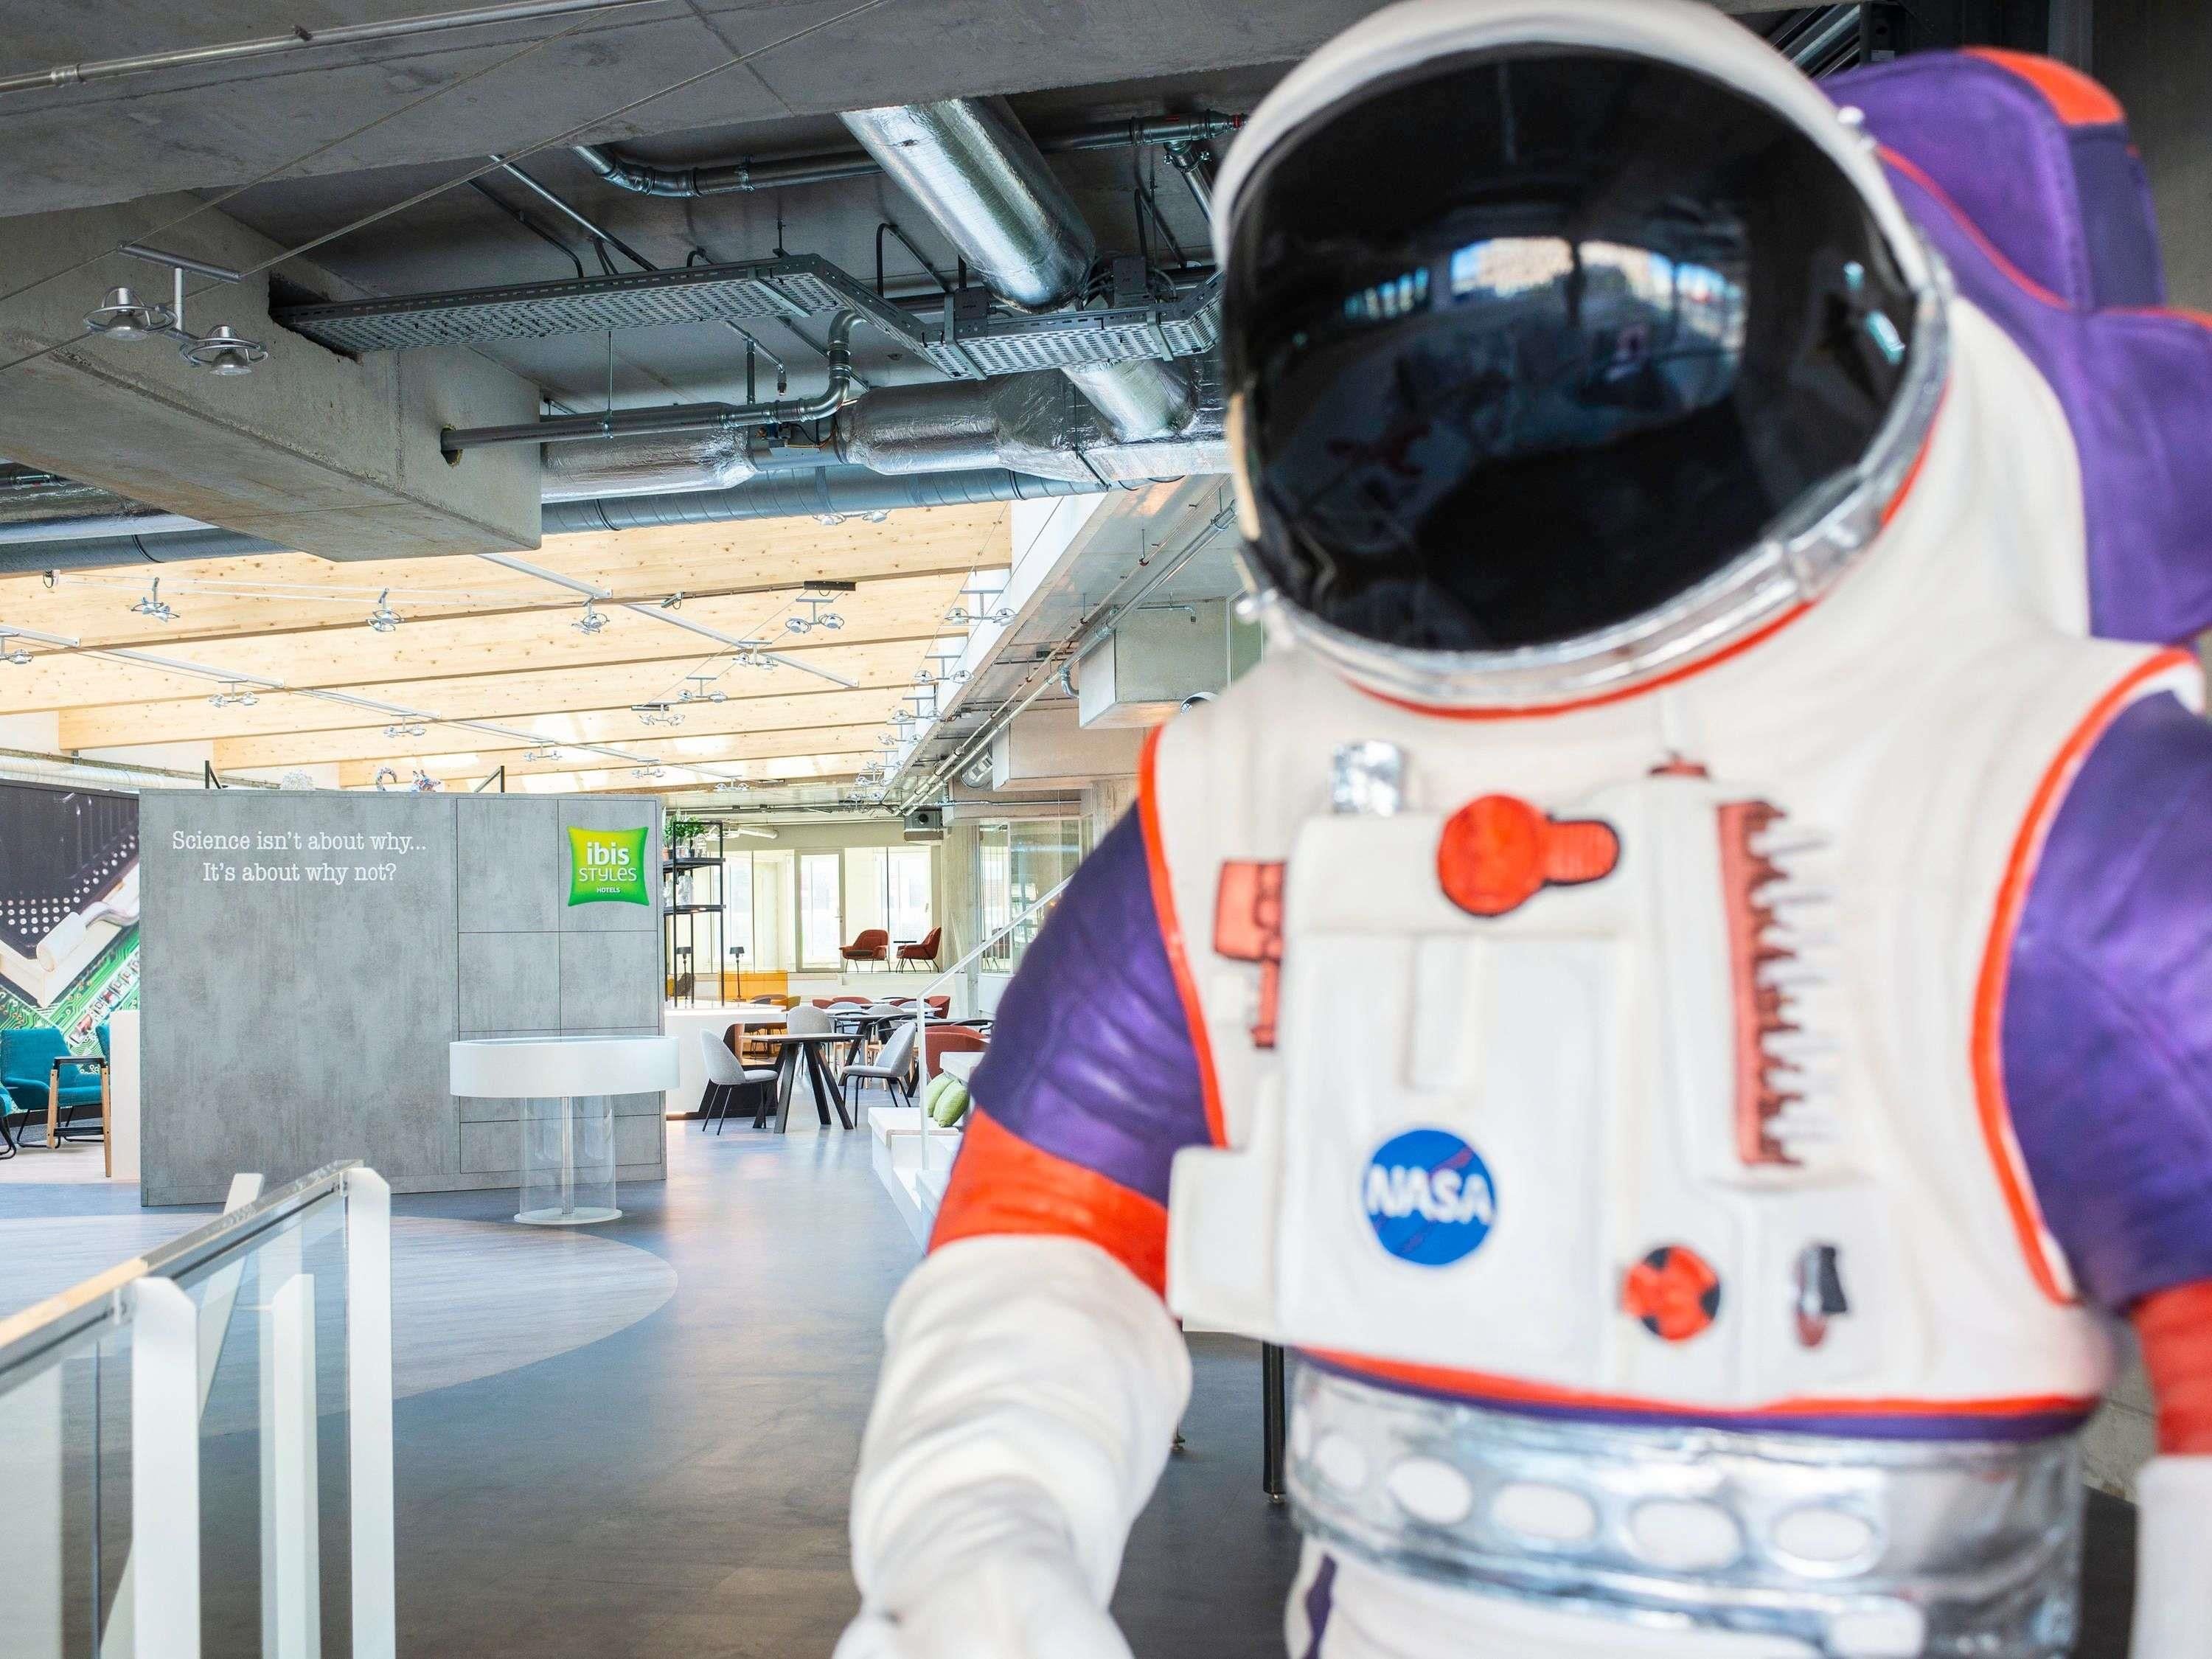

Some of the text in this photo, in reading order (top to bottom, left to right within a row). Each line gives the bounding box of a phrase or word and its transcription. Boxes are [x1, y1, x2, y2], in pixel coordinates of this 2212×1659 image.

[172, 830, 427, 855] Science isn’t about why...
[587, 841, 630, 866] ibis
[202, 862, 397, 886] It’s about why not?
[1367, 1164, 1496, 1226] NASA
